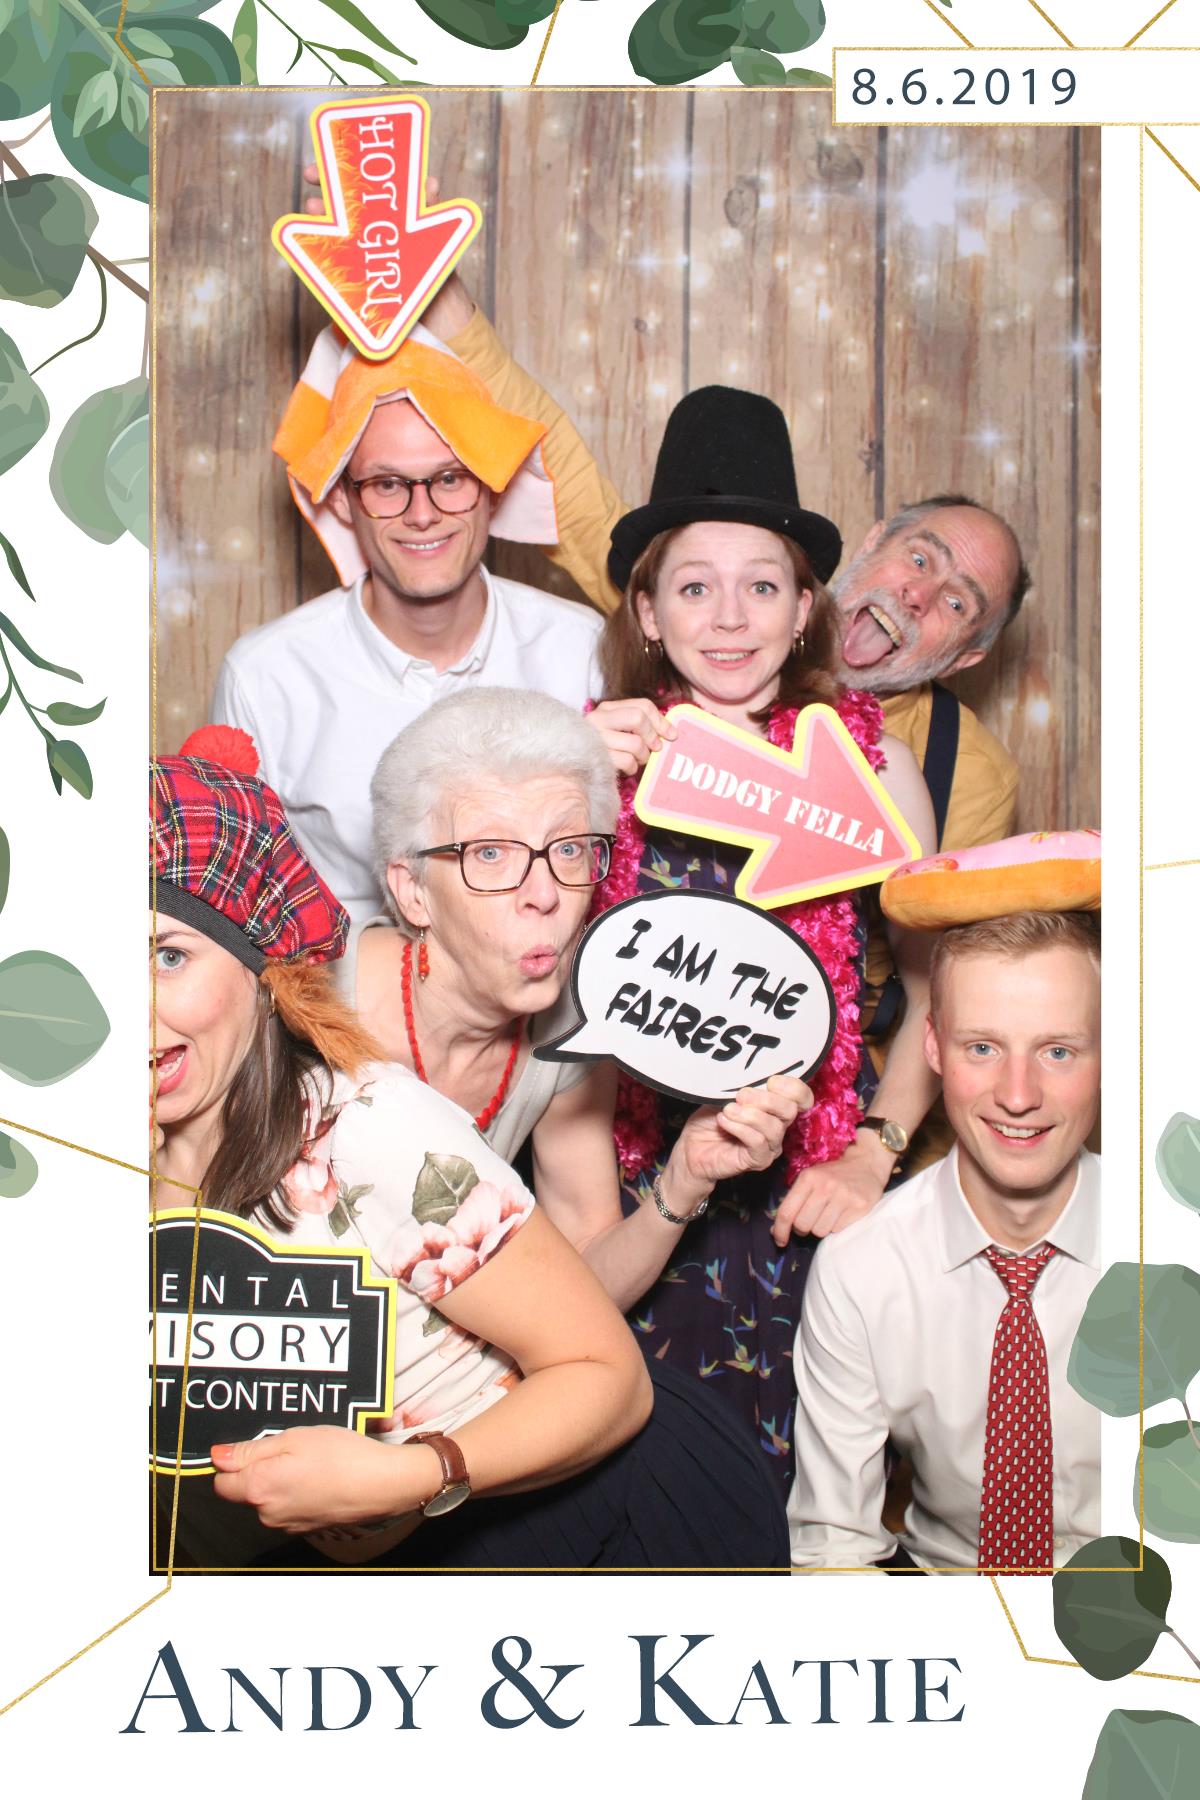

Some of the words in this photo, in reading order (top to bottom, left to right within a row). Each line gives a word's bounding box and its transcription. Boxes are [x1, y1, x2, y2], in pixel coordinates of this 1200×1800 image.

[358, 116, 398, 211] HOT
[357, 220, 402, 321] GIRL
[668, 754, 782, 816] DODGY
[784, 797, 885, 857] FELLA
[616, 919, 652, 959] I
[653, 935, 717, 985] AM
[729, 962, 808, 1020] THE
[605, 983, 780, 1069] FAIREST
[161, 1273, 348, 1309] ENTAL
[149, 1319, 348, 1364] ISORY
[186, 1379, 347, 1413] CONTENT
